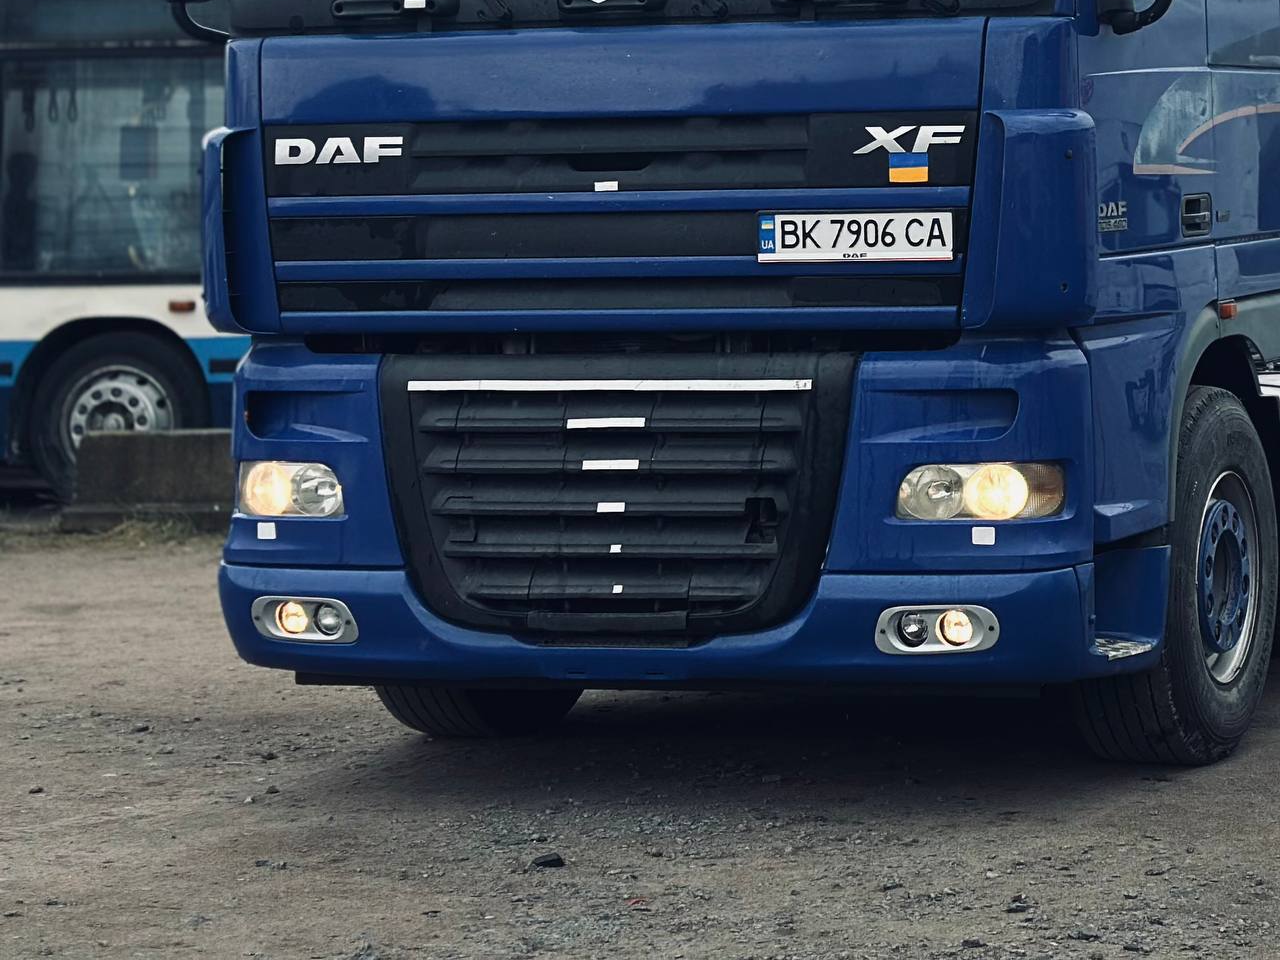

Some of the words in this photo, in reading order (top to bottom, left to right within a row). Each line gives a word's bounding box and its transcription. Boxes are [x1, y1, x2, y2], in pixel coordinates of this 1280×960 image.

[275, 136, 404, 165] DAF
[853, 125, 966, 154] XF
[1098, 201, 1128, 217] DAF
[761, 240, 774, 249] UA
[780, 219, 822, 250] BK
[829, 218, 896, 249] 7906
[905, 217, 947, 248] CA
